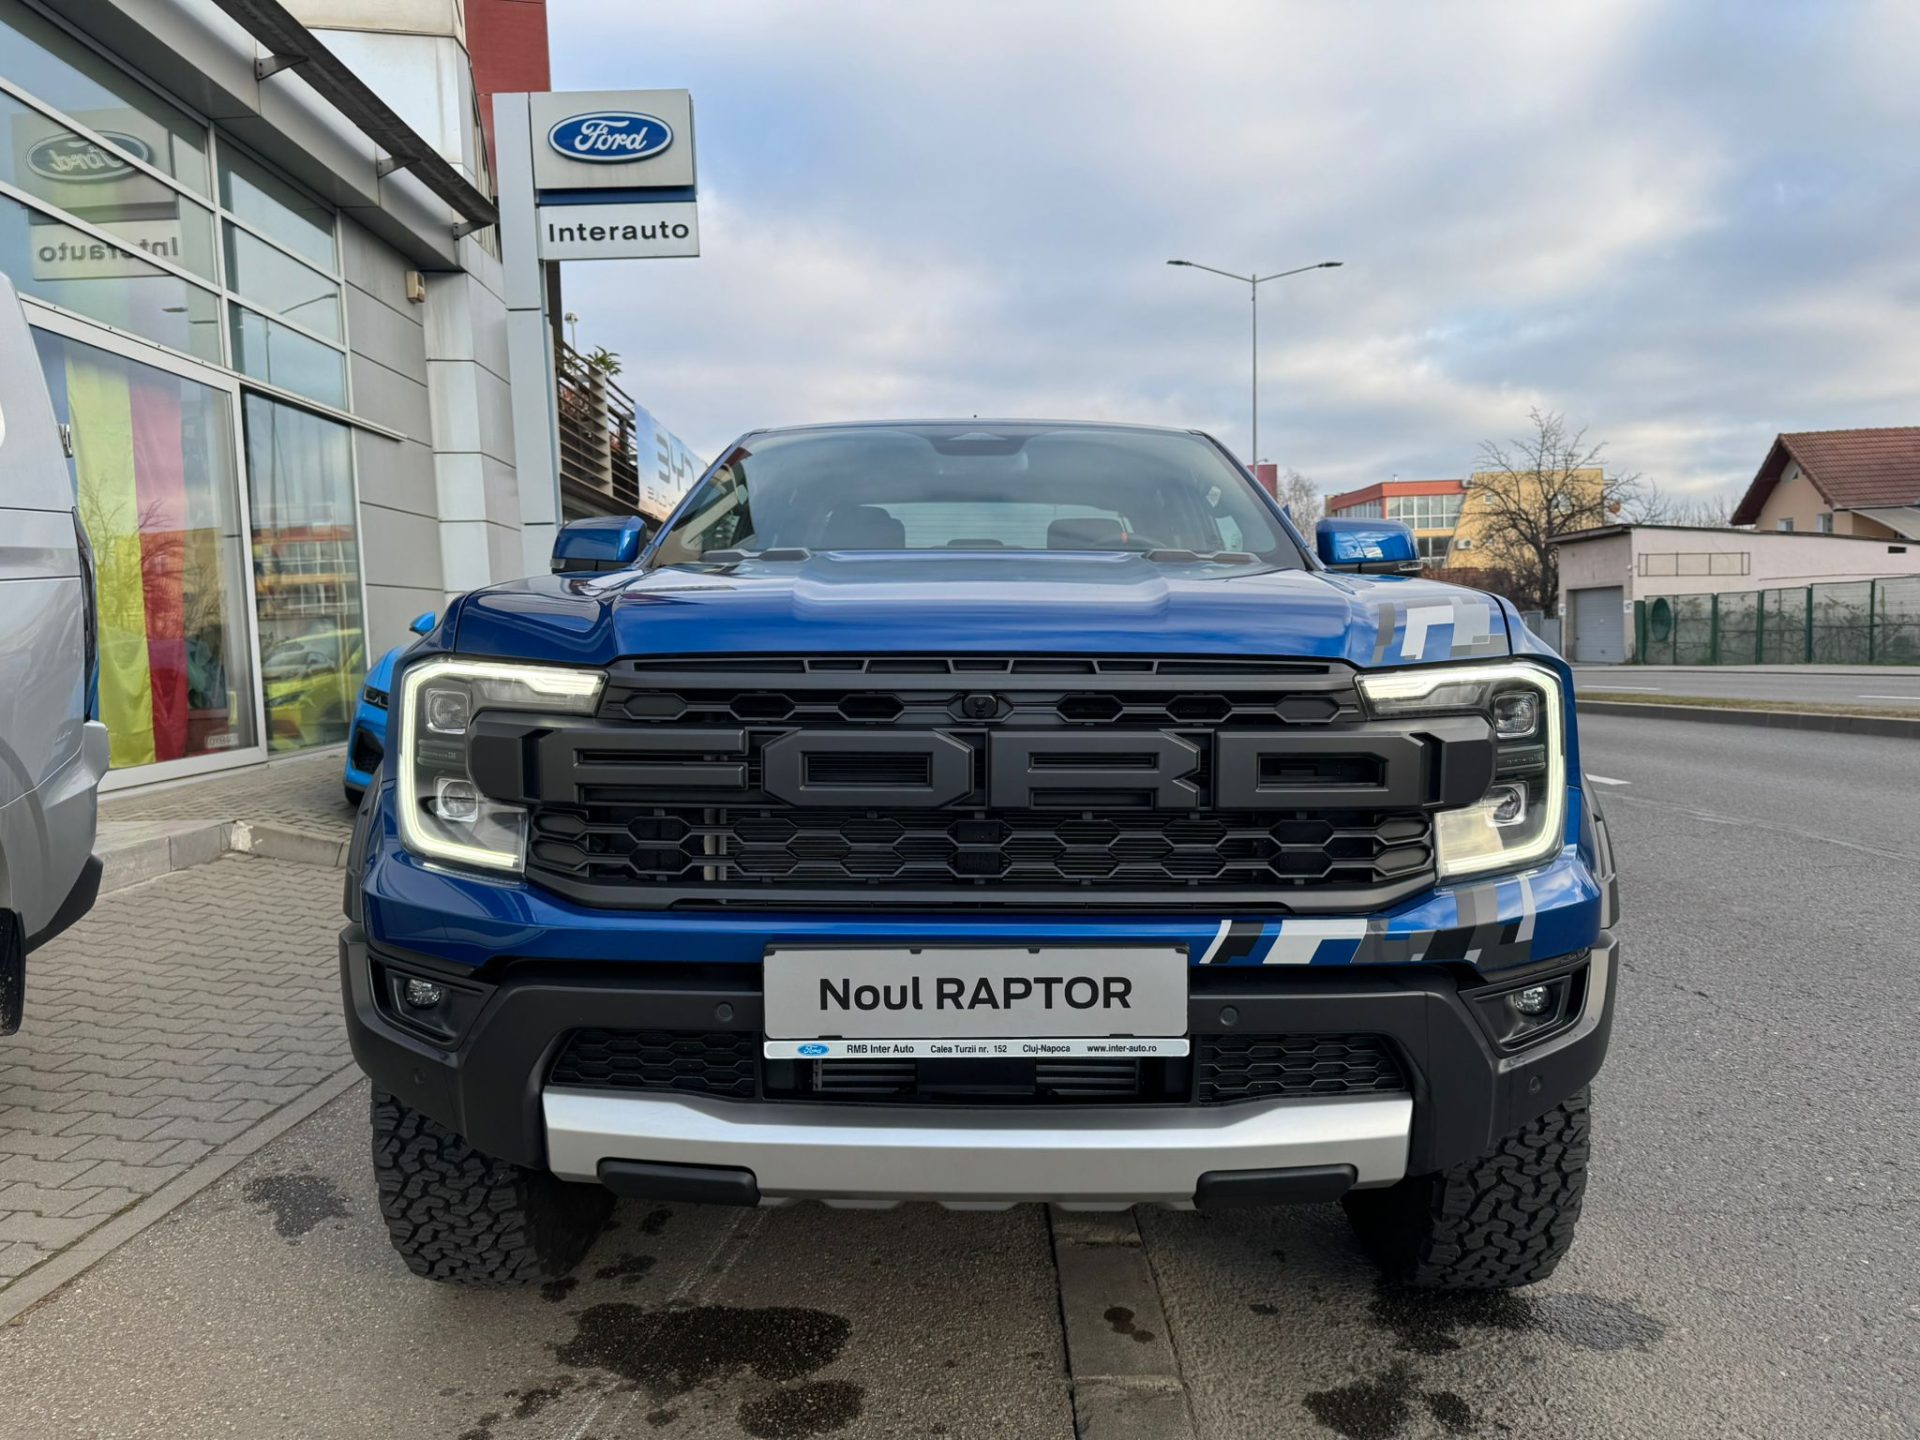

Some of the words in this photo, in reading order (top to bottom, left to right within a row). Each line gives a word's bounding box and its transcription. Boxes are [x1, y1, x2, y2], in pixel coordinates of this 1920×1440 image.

[574, 119, 648, 151] Ford
[549, 221, 689, 242] Interauto
[540, 727, 1426, 808] FORD
[820, 976, 923, 1011] Noul
[936, 976, 1132, 1010] RAPTOR
[846, 1044, 868, 1054] RMB
[870, 1044, 890, 1054] Inter
[892, 1044, 915, 1054] Auto
[930, 1044, 953, 1054] Calea
[955, 1044, 977, 1054] Turzii
[978, 1045, 989, 1054] nr.
[994, 1044, 1007, 1053] 152
[1022, 1044, 1071, 1055] Cluj-Napoca
[1087, 1043, 1157, 1053] www.inter-auto.ro
